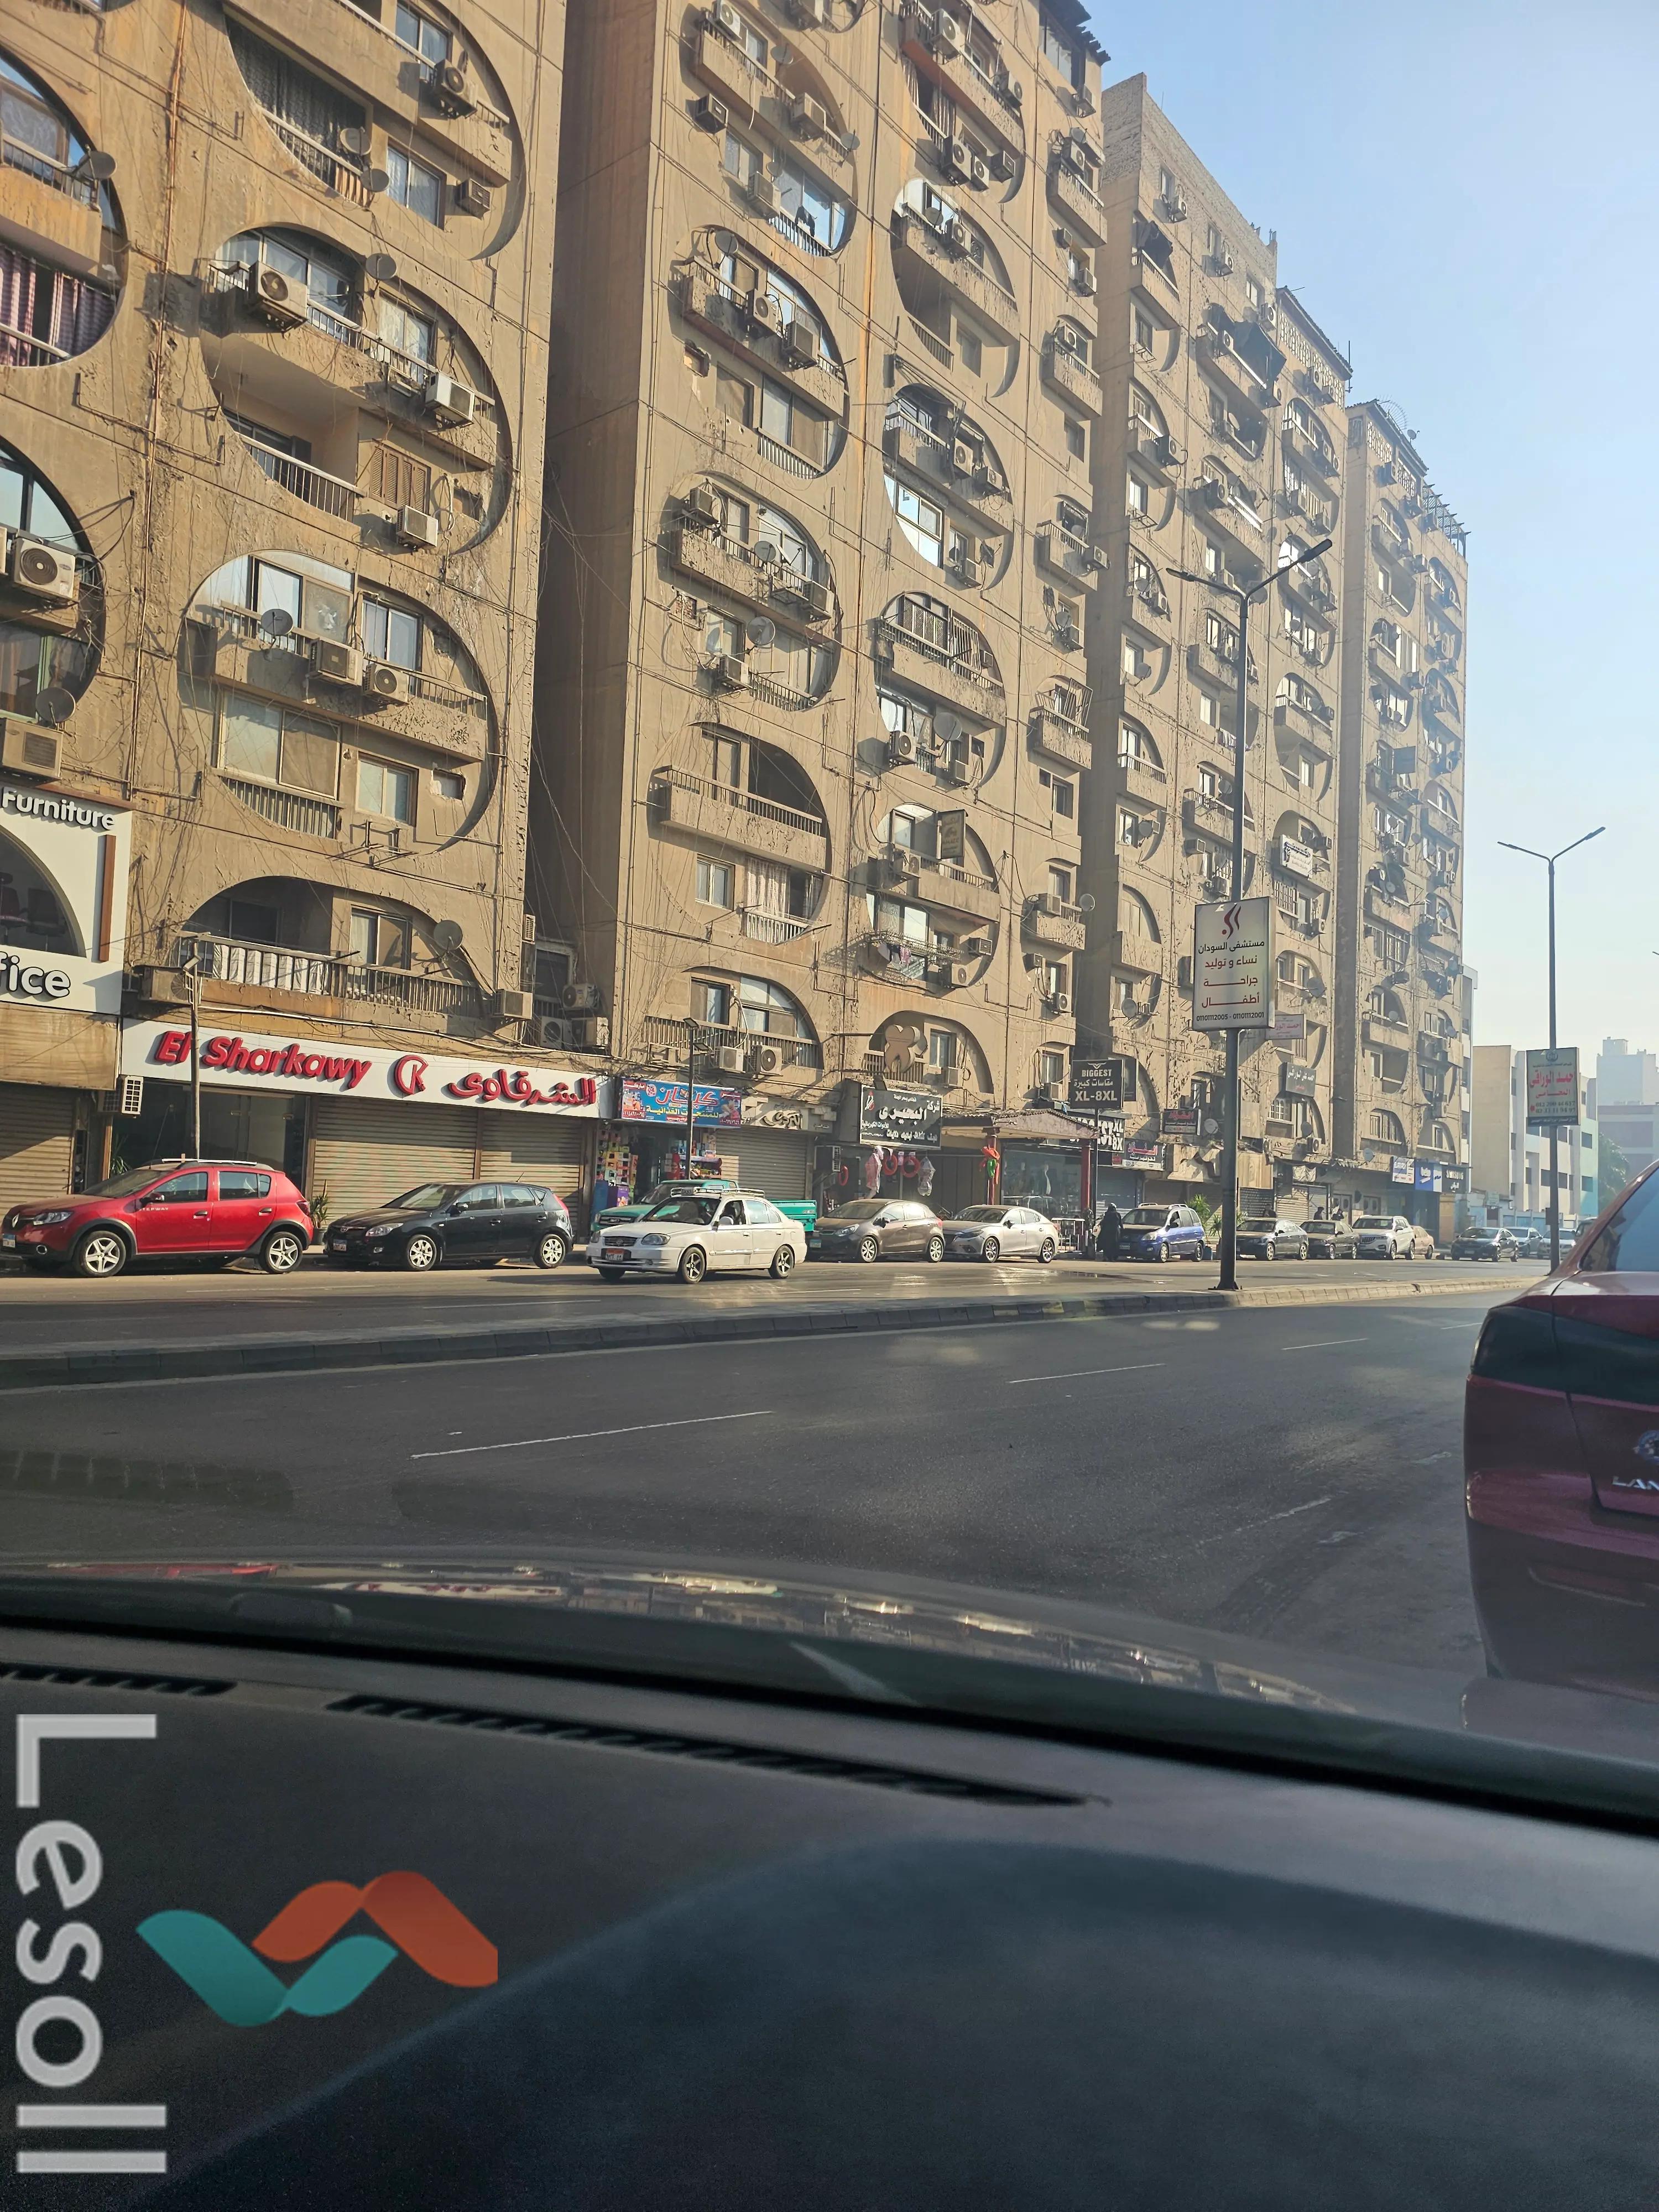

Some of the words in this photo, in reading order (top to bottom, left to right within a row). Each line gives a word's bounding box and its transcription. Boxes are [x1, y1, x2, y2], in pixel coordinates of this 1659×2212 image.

[2, 786, 116, 831] Furniture
[1198, 942, 1228, 954] السودان
[1229, 939, 1265, 951] مستشفى
[1204, 958, 1228, 969] توليد
[1228, 959, 1234, 968] و
[1236, 955, 1258, 965] نساء
[1203, 974, 1258, 987] جراحة
[1201, 992, 1260, 1008] أطفال
[154, 1031, 191, 1063] El
[201, 1036, 372, 1089] Sharkawy
[1082, 1069, 1113, 1077] BIGGEST
[448, 1068, 597, 1106] الشرقاوى
[1073, 1079, 1091, 1089] كبيرة
[1074, 1090, 1118, 1102] XL-8XL
[926, 1099, 940, 1113] شركة
